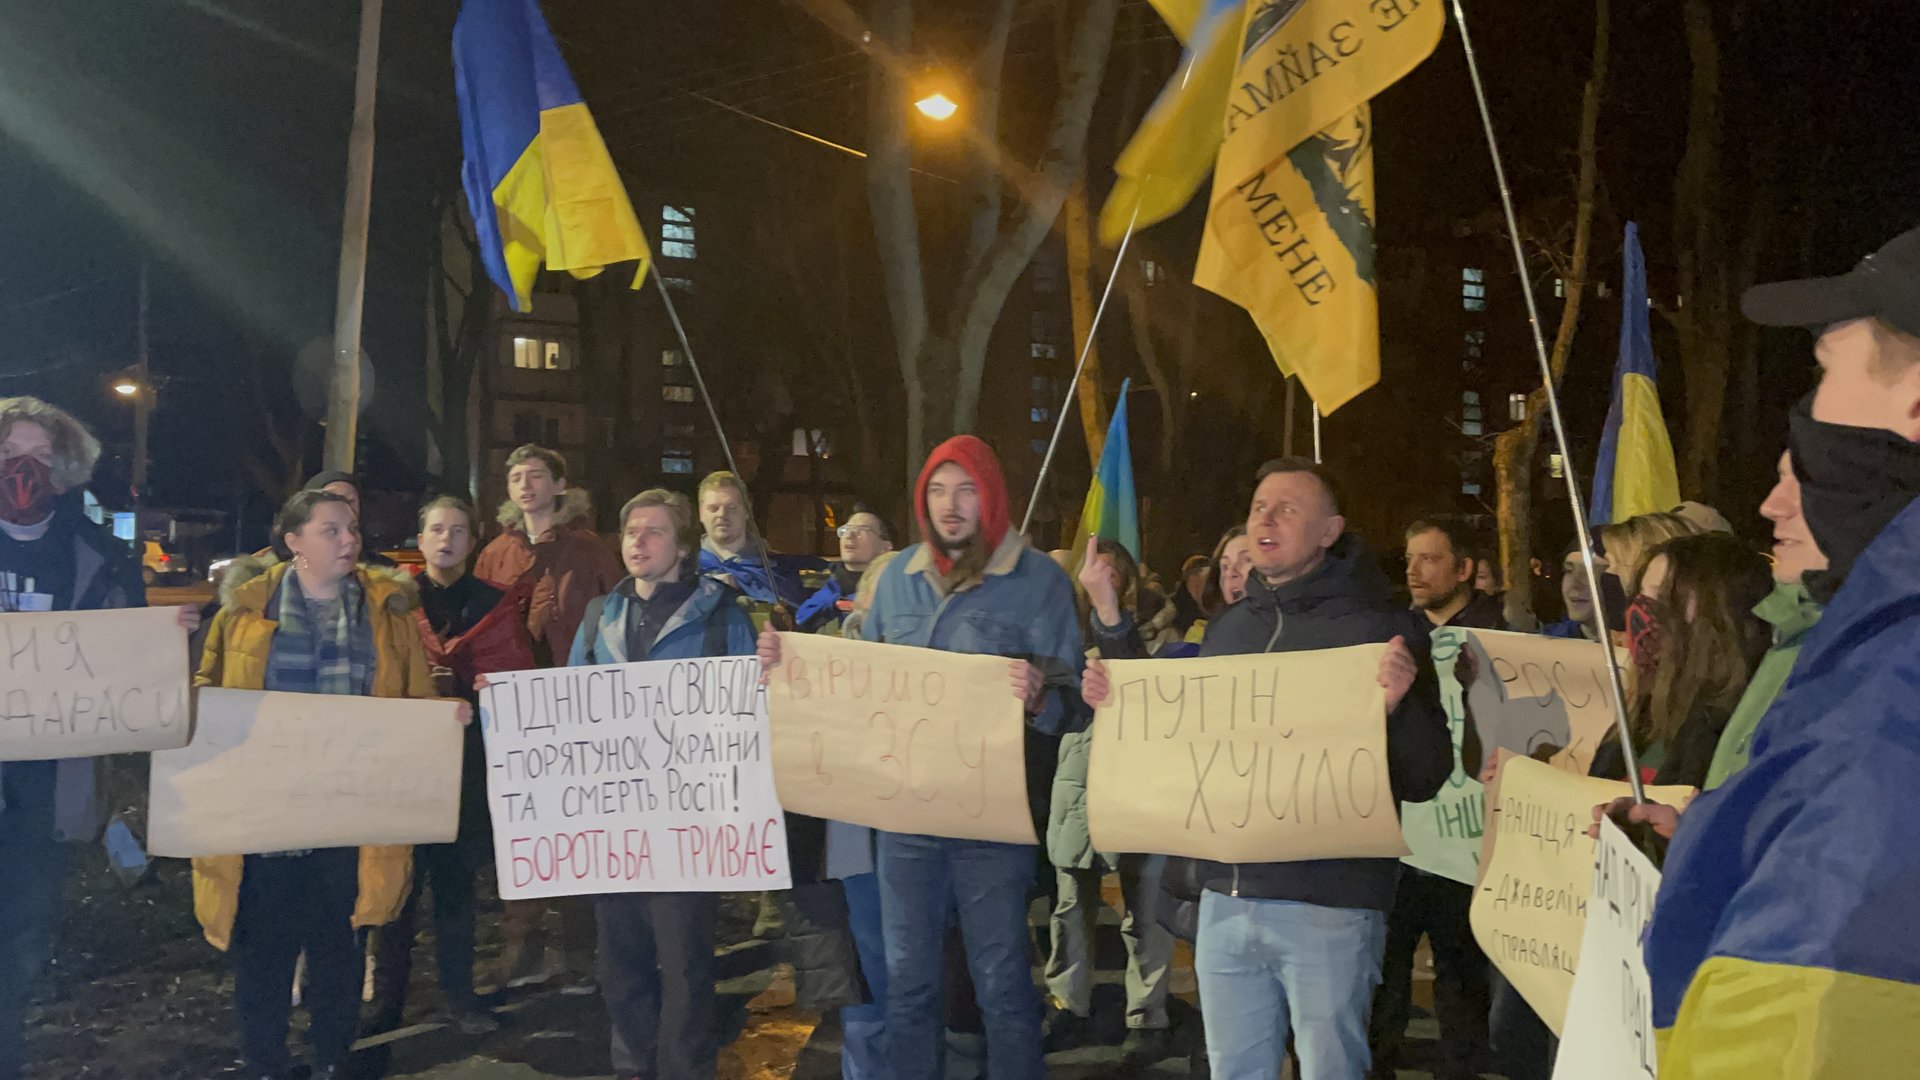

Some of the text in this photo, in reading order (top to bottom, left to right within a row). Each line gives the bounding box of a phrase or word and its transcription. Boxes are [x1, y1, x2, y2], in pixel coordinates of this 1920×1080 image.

[1236, 168, 1337, 306] МЕНЕ
[489, 669, 631, 737] ГІДНІСТЬ
[667, 658, 769, 721] СВОБОДА
[1117, 666, 1280, 742] ПУТІН
[1490, 657, 1628, 708] РОСІ
[501, 791, 537, 822] ТА
[561, 778, 658, 817] СМЕРТЬ
[868, 711, 987, 819] ЗСУ
[1185, 729, 1378, 834] ХУЙЛО
[510, 818, 777, 888] БОРОТЬБА ТРИВАЄ
